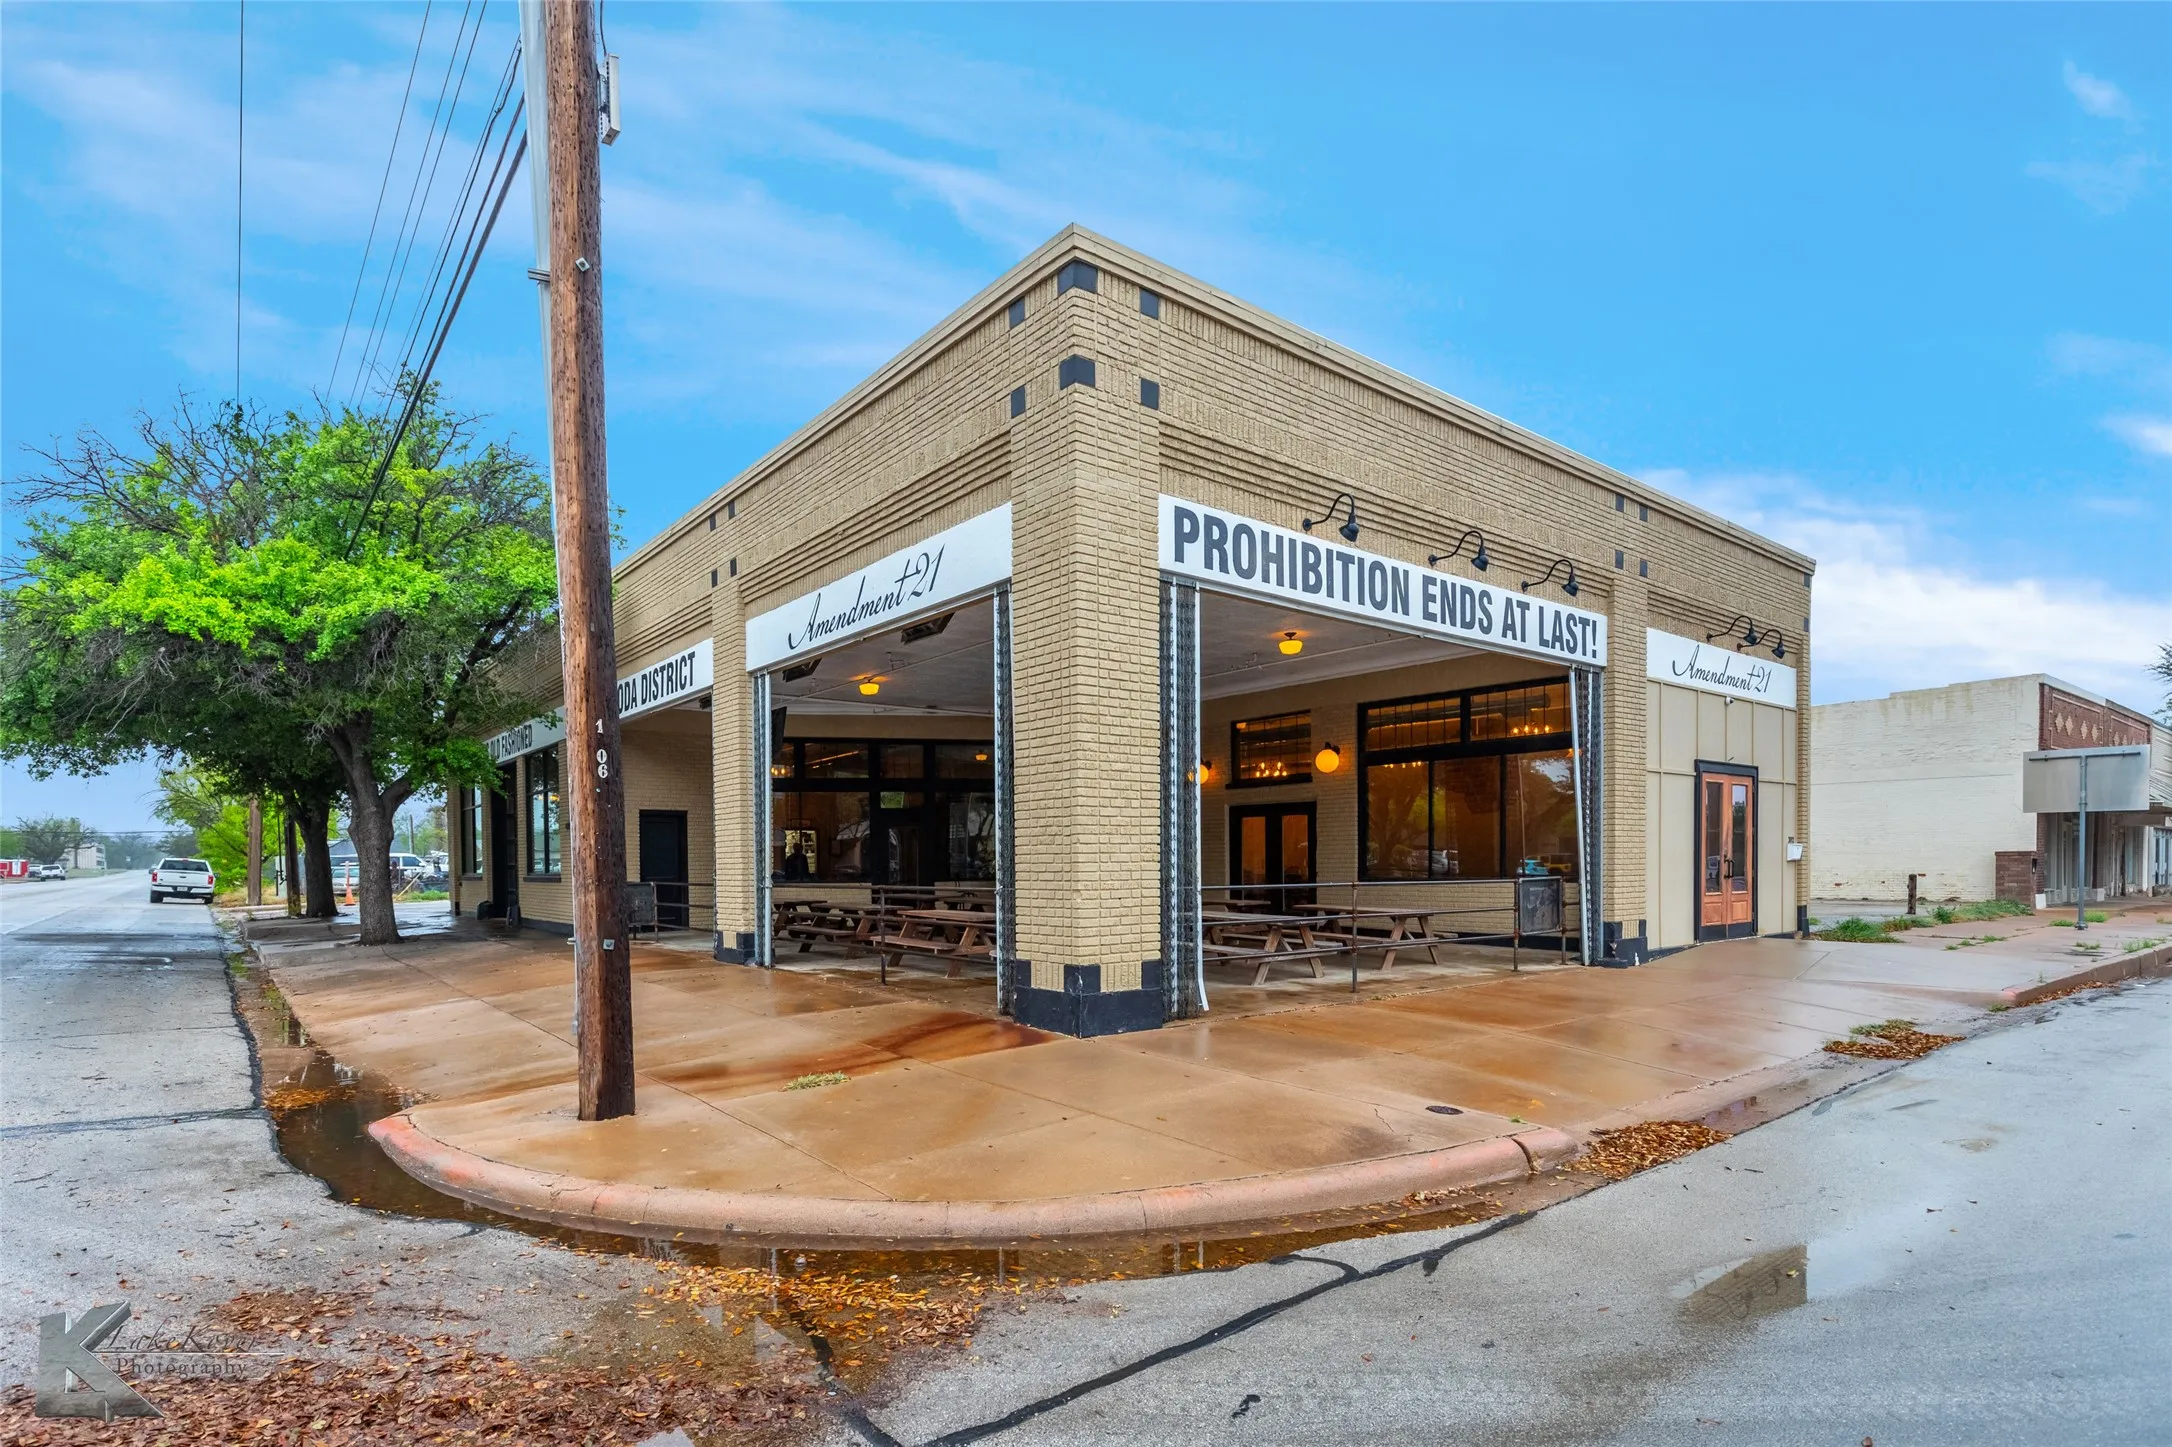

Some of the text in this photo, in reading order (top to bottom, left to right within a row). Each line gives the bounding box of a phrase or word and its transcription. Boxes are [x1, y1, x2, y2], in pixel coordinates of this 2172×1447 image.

[788, 544, 945, 650] Amendment 21
[1174, 505, 1597, 659] PROHIBITION ENDS AT LAST!
[641, 651, 696, 706] DISTRICT
[1672, 644, 1772, 693] Amendment 21
